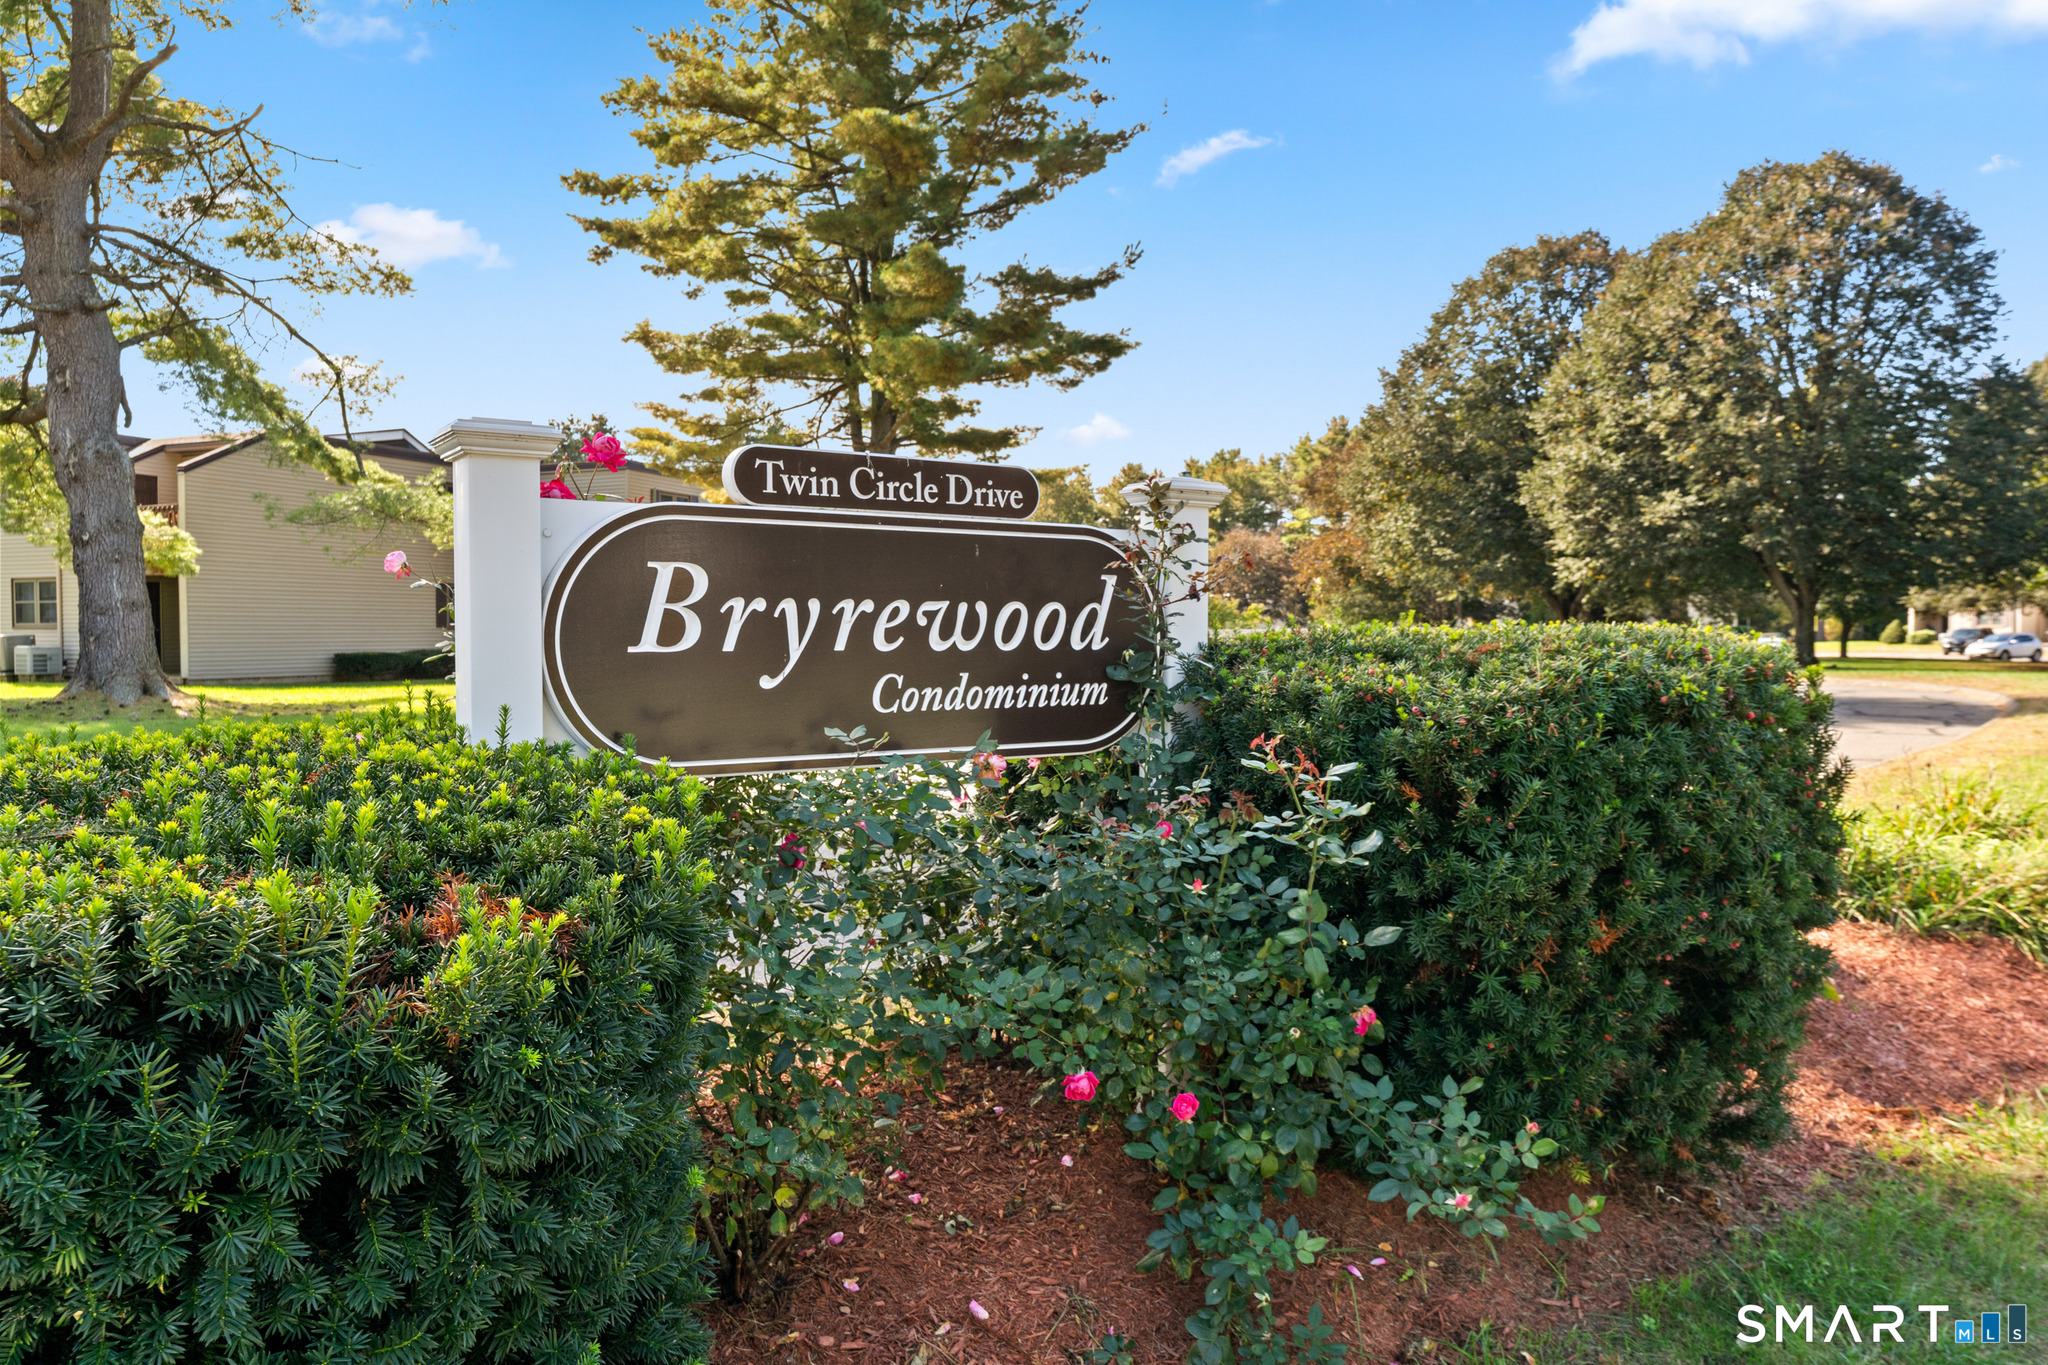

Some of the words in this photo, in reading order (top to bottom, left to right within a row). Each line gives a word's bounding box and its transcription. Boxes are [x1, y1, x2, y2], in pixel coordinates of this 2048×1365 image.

[754, 458, 842, 498] Twin
[849, 466, 938, 505] Circle
[946, 472, 1024, 510] Drive
[627, 560, 1118, 690] Bryrewood
[872, 672, 1108, 714] Condominium
